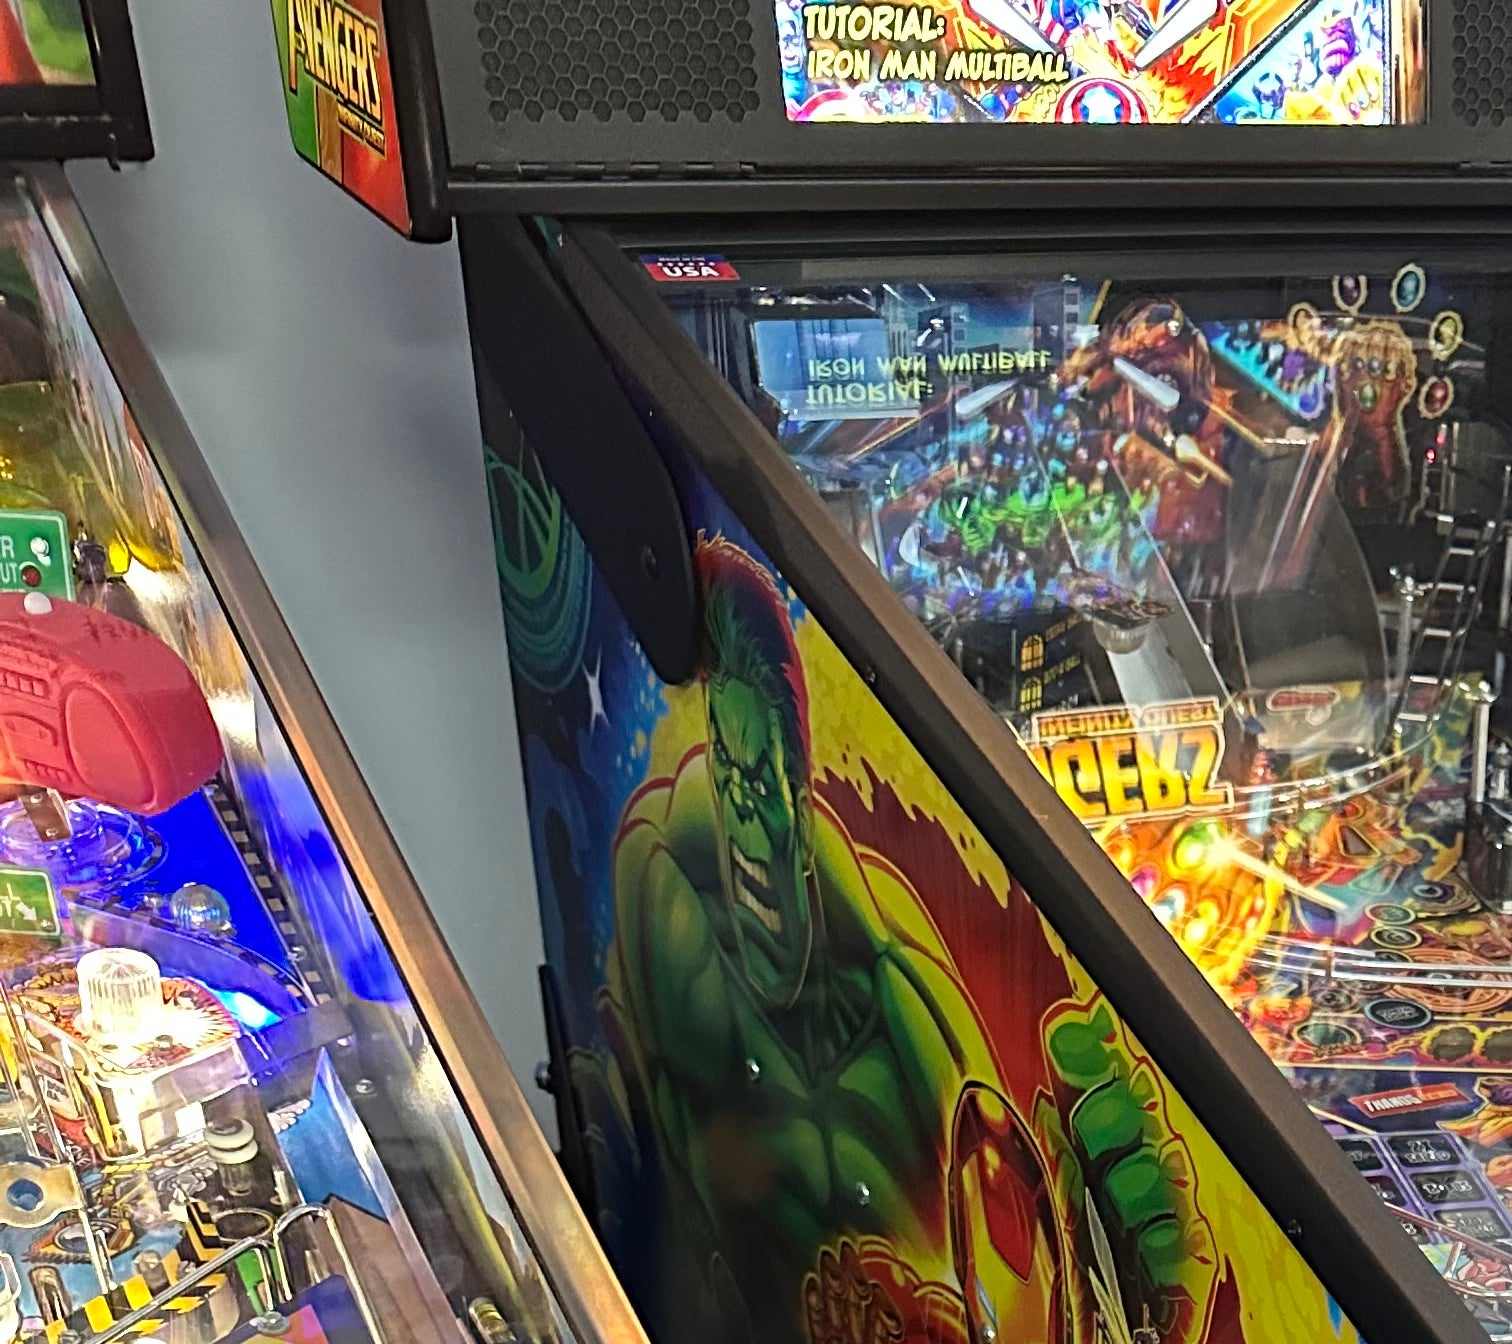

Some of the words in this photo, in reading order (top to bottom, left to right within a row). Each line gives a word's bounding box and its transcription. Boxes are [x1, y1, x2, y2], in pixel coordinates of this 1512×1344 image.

[804, 6, 946, 42] TUTORIAL:
[807, 49, 871, 80] IRON
[879, 50, 936, 81] MAN
[945, 52, 1070, 82] MULTIBALL
[662, 266, 720, 277] USA
